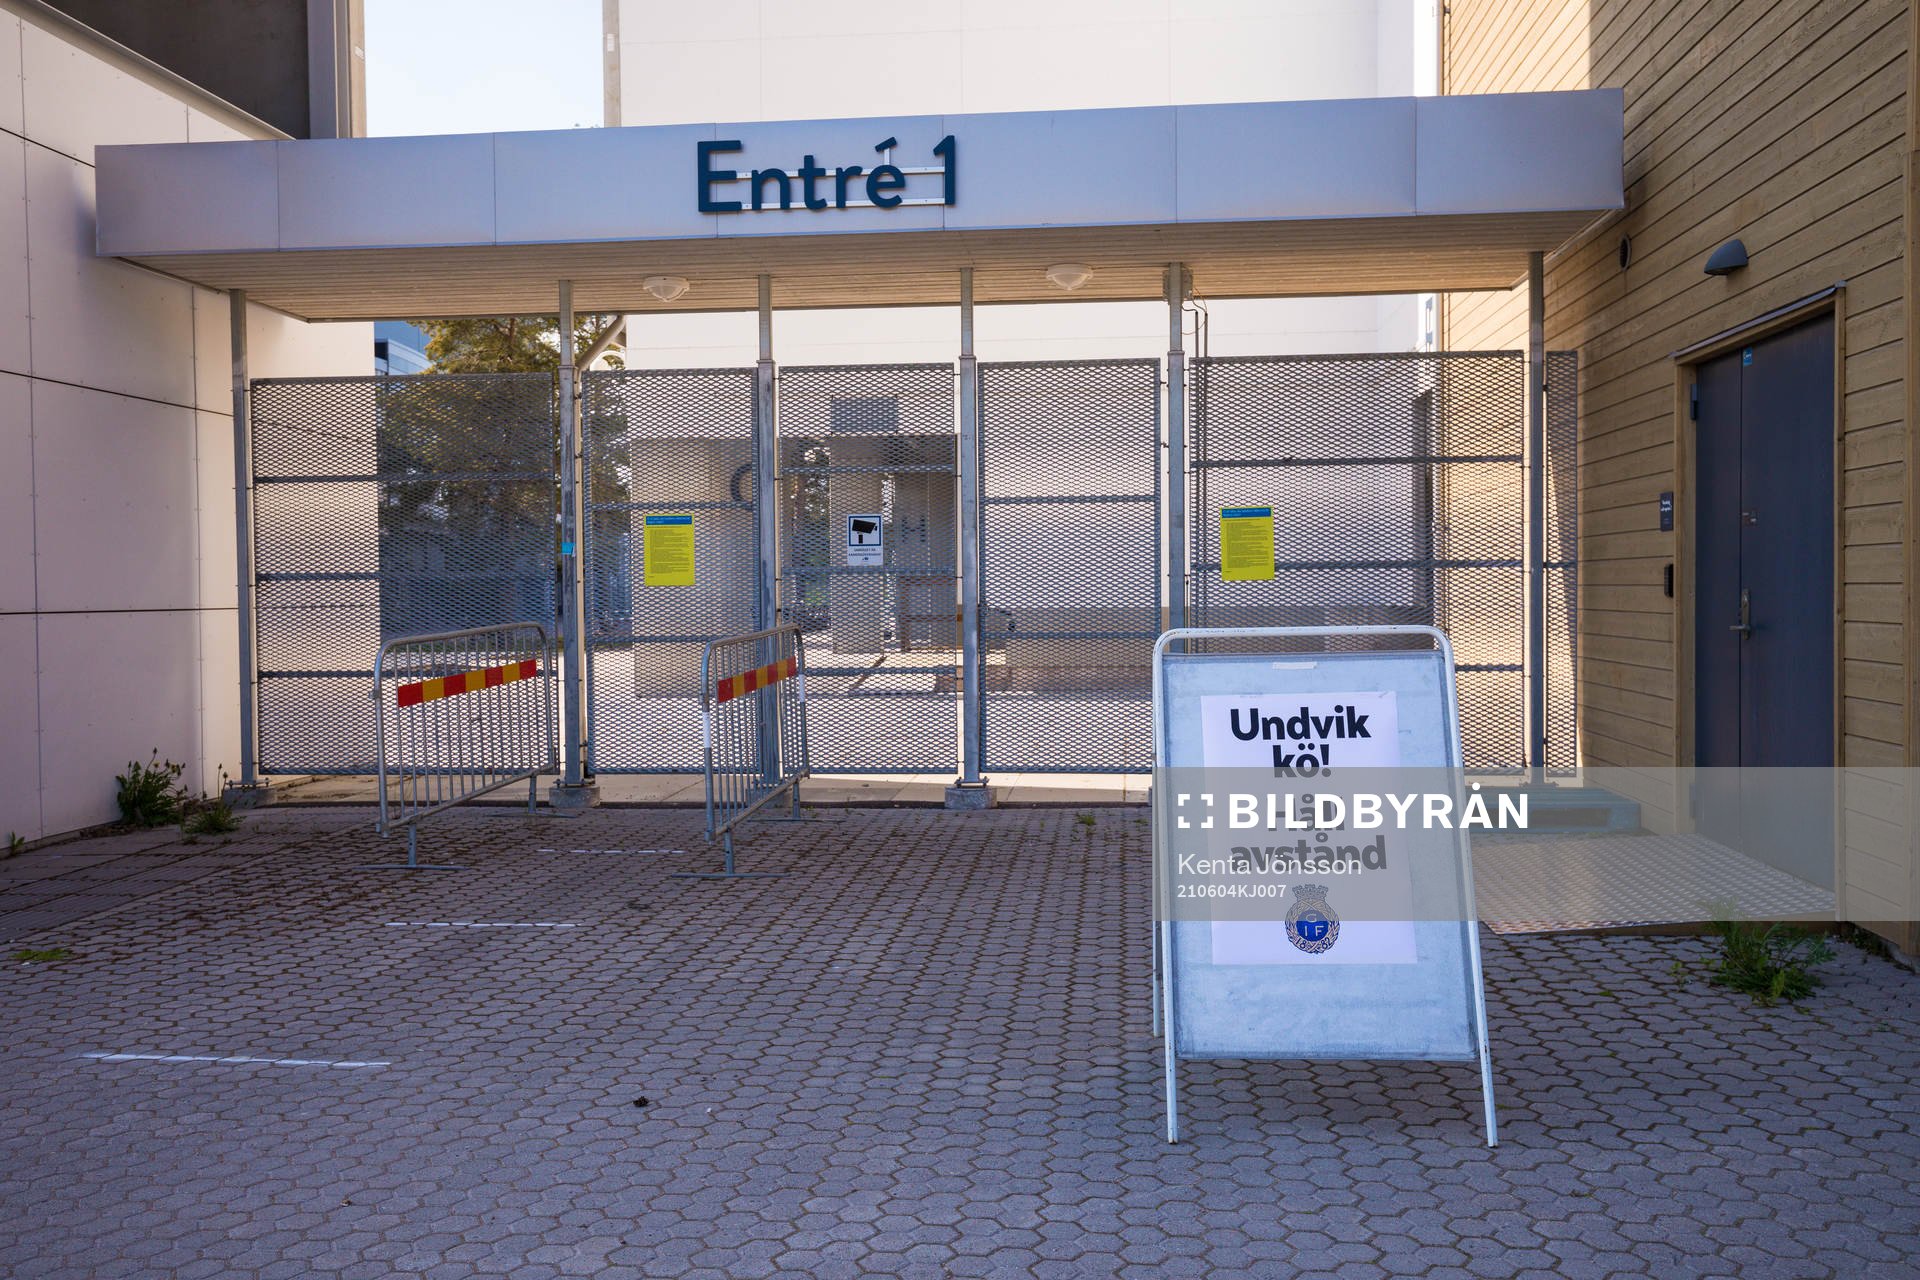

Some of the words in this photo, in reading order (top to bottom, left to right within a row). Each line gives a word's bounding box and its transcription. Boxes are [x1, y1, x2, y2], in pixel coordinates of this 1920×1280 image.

[697, 136, 906, 212] Entré
[933, 134, 956, 206] 1
[1230, 704, 1371, 741] Undvik
[1272, 742, 1332, 778] kö!
[1230, 832, 1387, 871] avstånd
